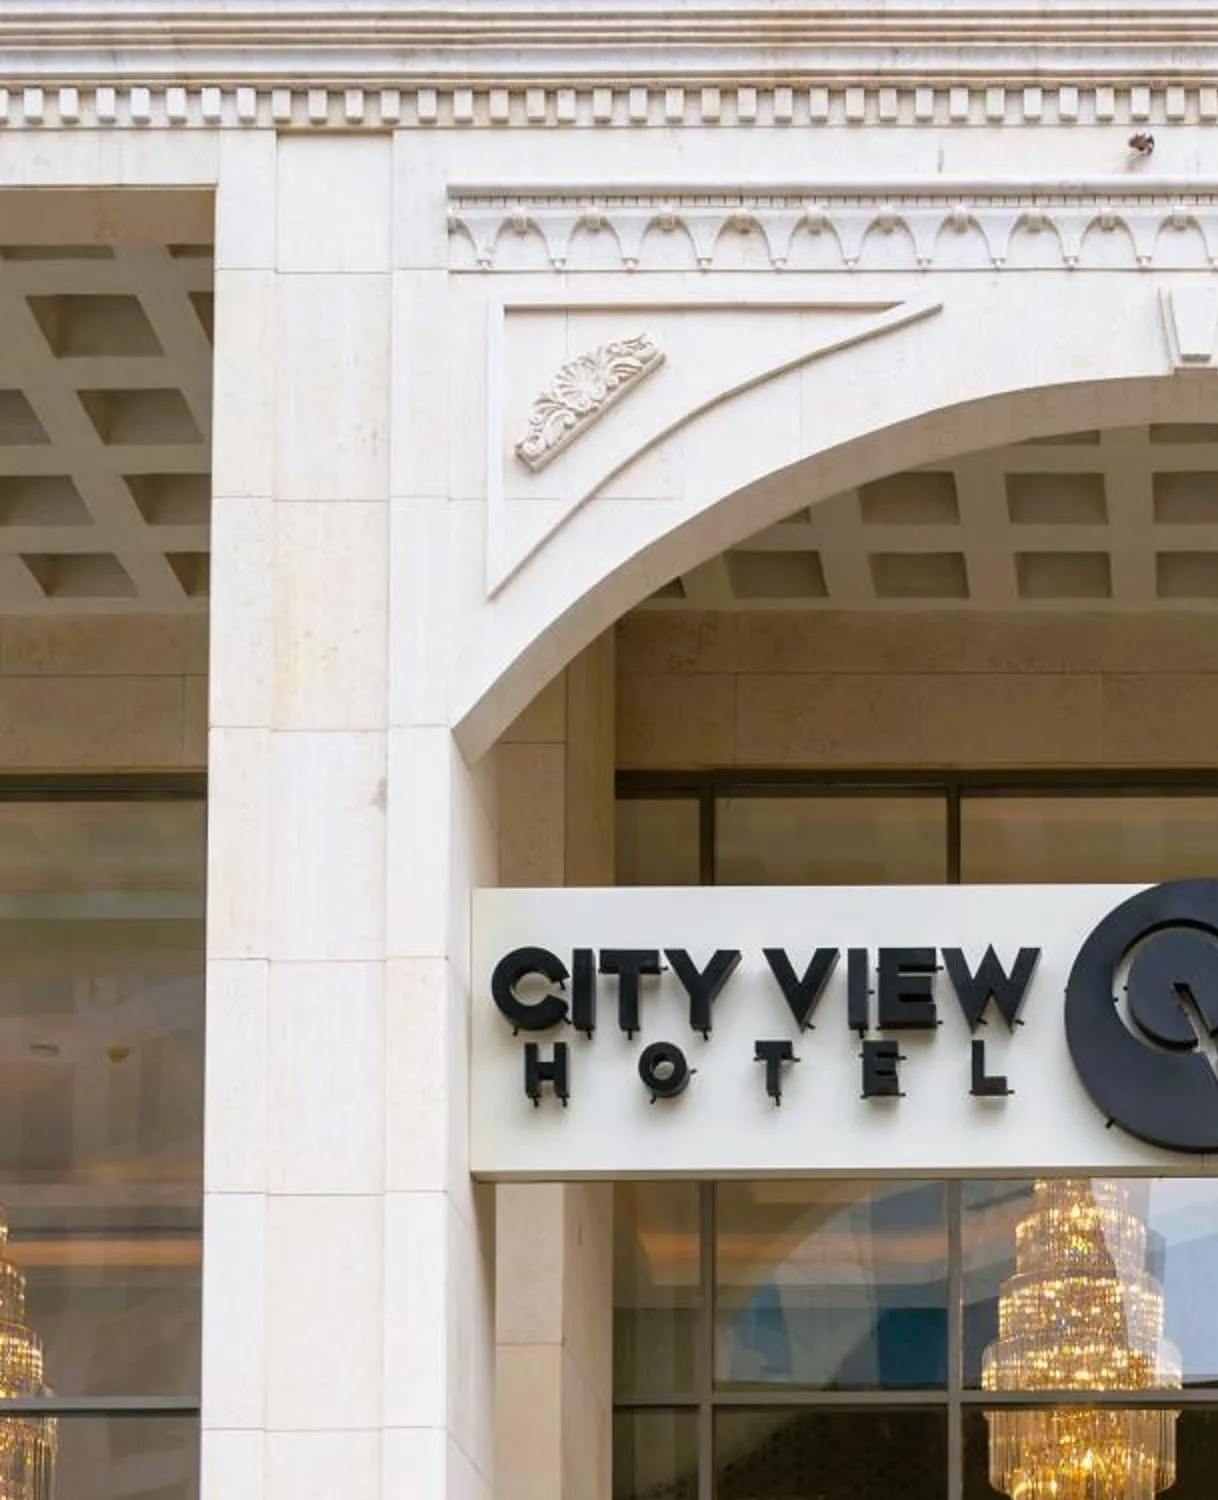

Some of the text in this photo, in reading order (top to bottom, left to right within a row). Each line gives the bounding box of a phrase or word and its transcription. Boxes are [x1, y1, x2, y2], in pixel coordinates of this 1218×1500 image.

[492, 944, 1042, 1036] CITY VIEW
[524, 1039, 1016, 1108] HOTEL
